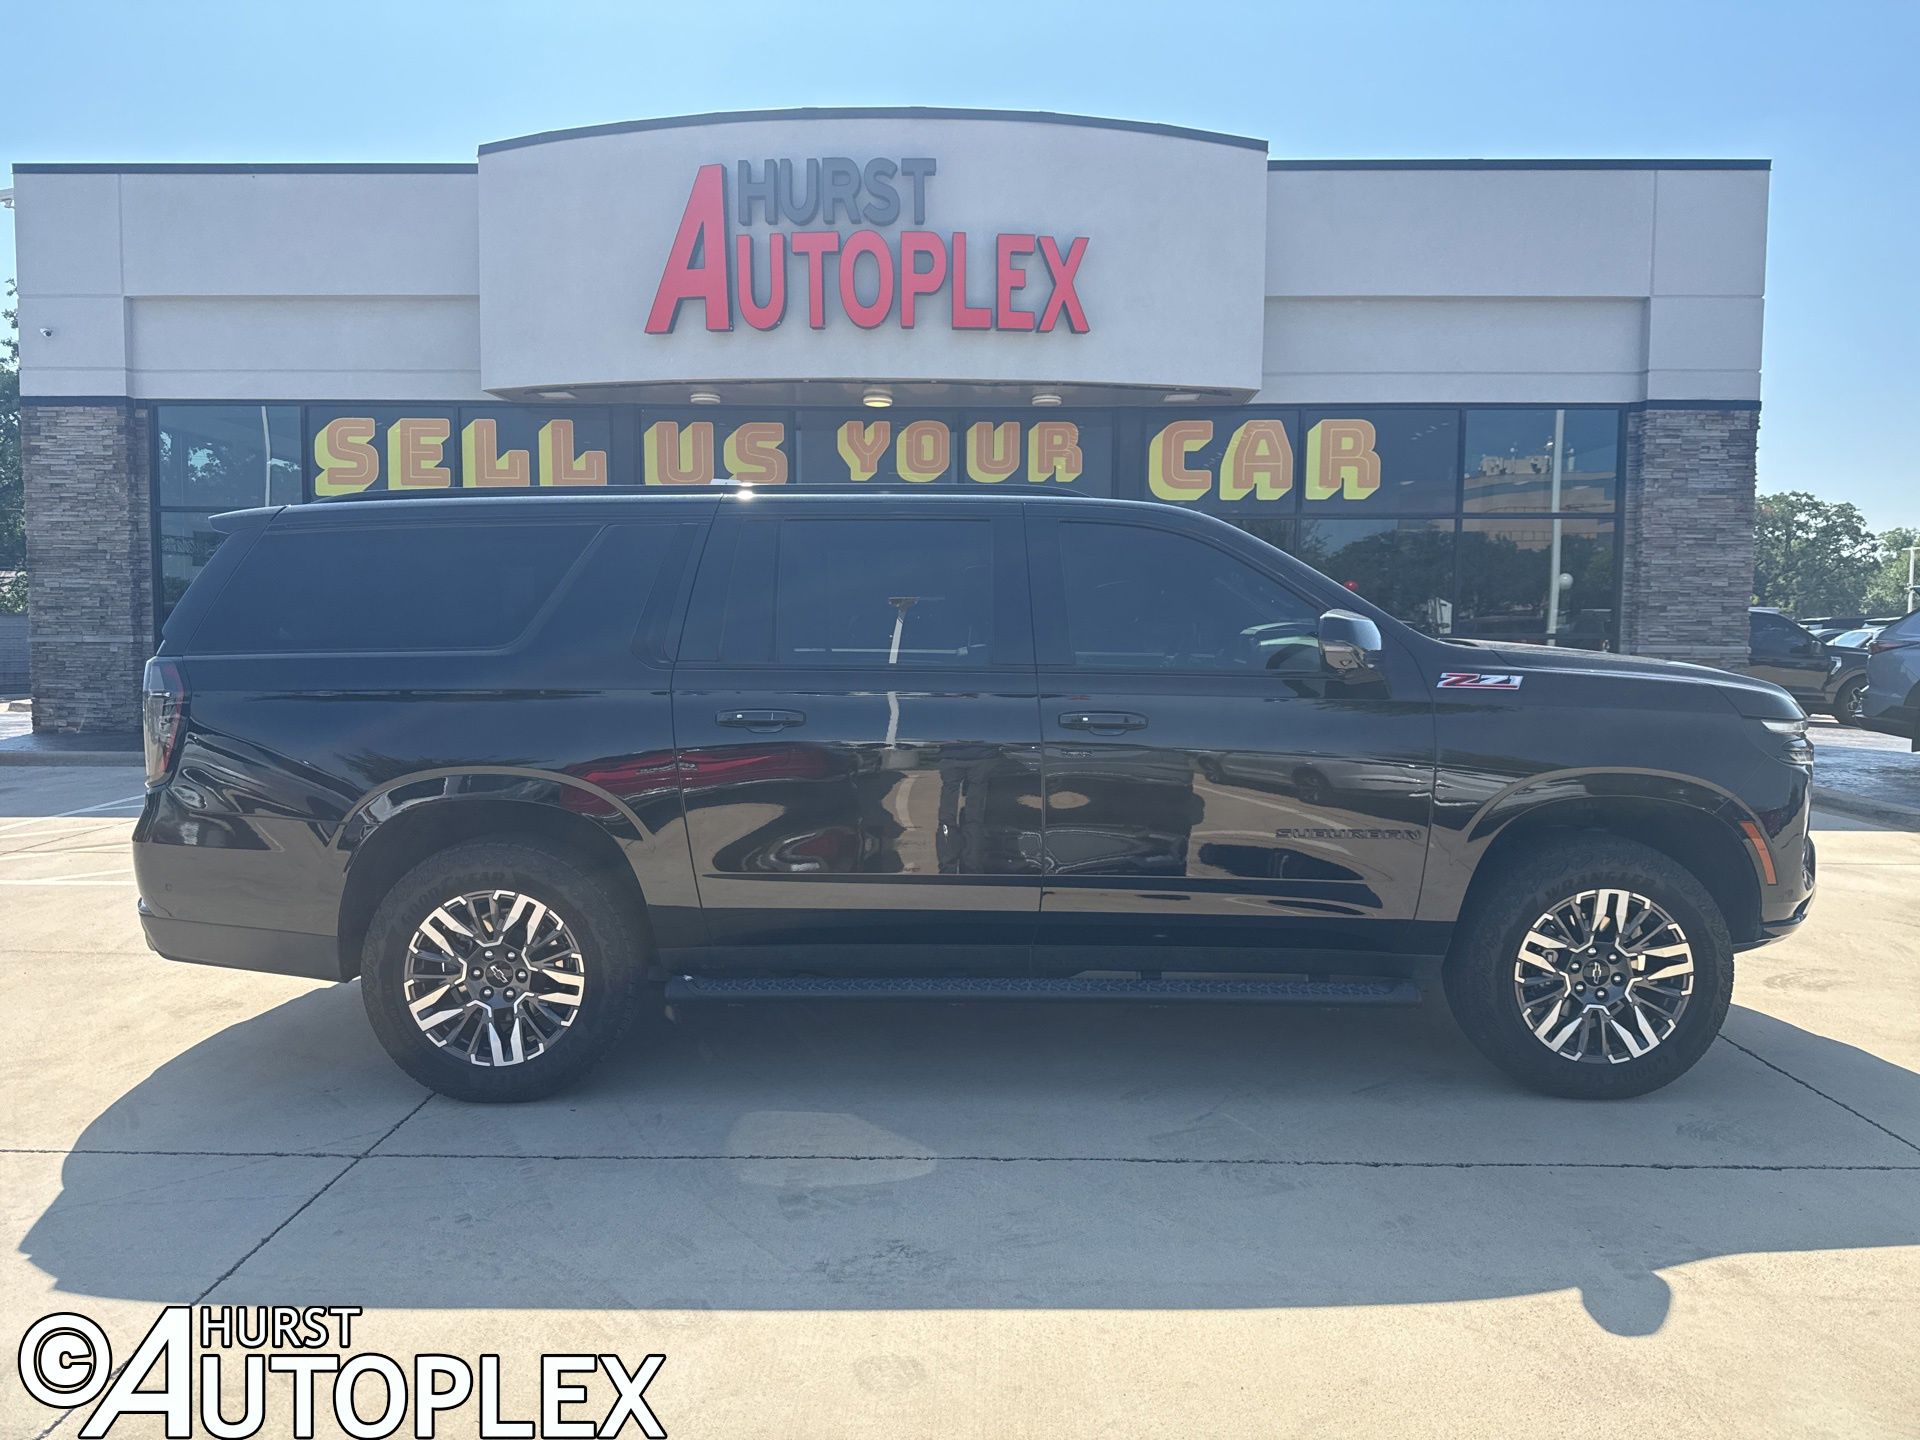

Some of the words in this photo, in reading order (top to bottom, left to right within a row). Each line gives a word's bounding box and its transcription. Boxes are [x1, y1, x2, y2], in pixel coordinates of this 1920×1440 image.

[738, 157, 937, 226] HURST
[645, 163, 1090, 334] AUTOPLEX
[315, 417, 607, 496] SELL
[644, 421, 788, 486] US
[837, 420, 1083, 483] YOUR
[1149, 419, 1381, 500] CAR
[1437, 672, 1524, 690] Z71
[1275, 828, 1421, 840] SUBURBAN
